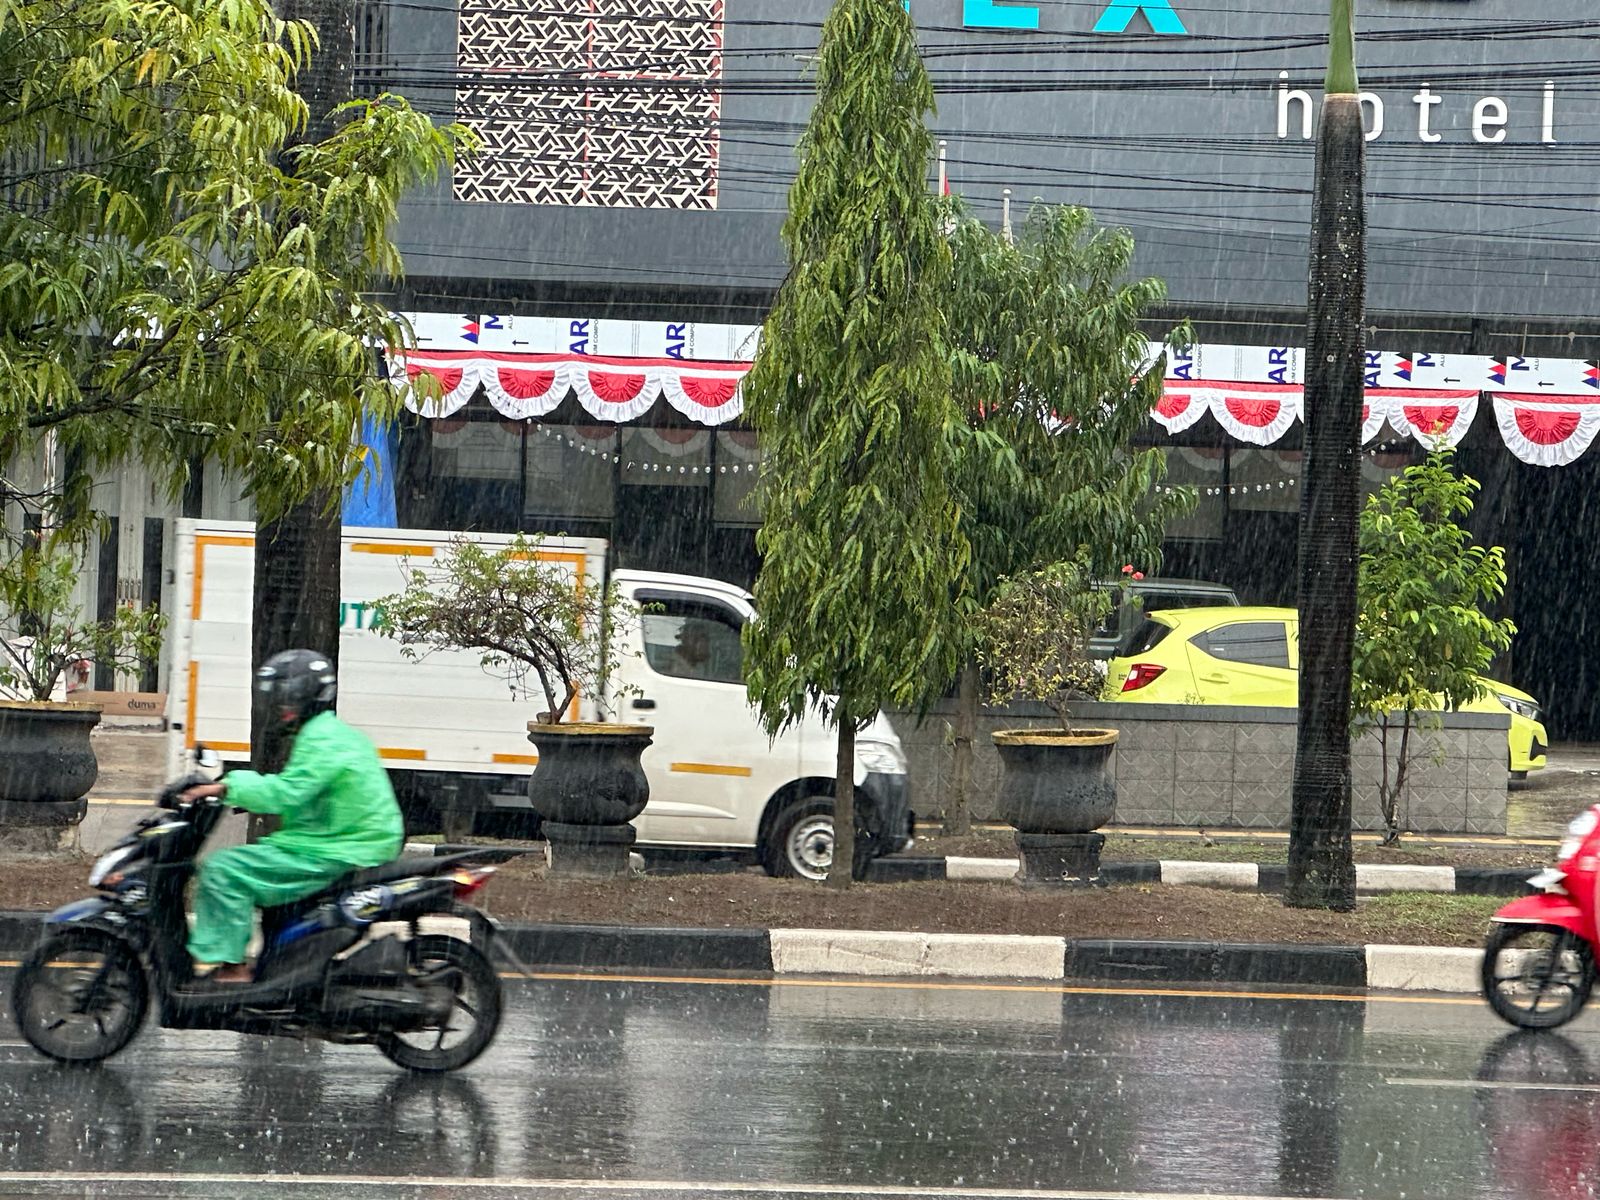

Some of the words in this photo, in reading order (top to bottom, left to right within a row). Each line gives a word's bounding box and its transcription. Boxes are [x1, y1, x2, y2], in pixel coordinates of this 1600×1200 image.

[569, 319, 590, 356] AR
[665, 322, 686, 359] AR
[1267, 346, 1288, 385] AR
[128, 699, 156, 709] duma
